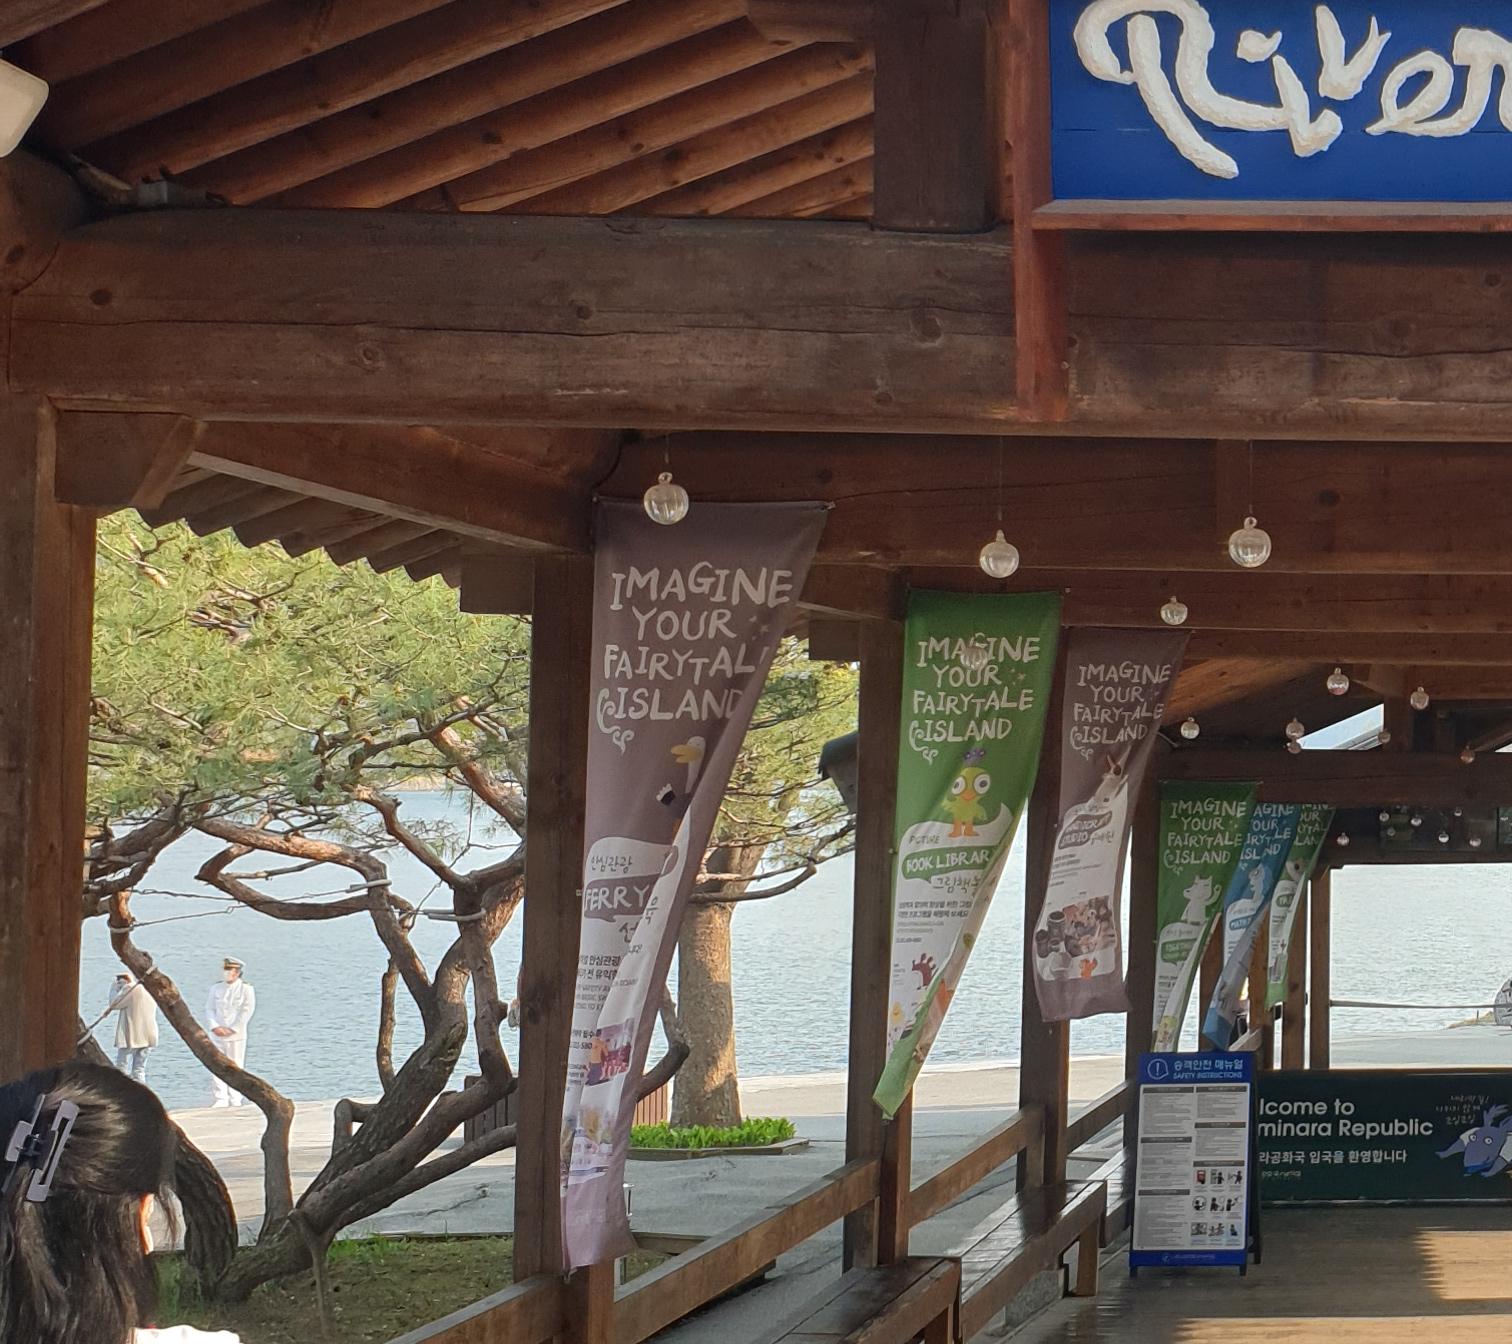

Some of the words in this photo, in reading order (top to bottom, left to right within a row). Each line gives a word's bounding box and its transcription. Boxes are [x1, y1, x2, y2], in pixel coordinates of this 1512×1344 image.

[610, 561, 793, 611] IMAGINE
[632, 606, 737, 641] YOUR
[604, 643, 770, 685] FAIRYTAL
[1077, 661, 1171, 686] IMAGINE
[932, 664, 1002, 688] YOUR
[913, 686, 1035, 717] FAIRYTALE
[1090, 685, 1145, 702] YOUR
[1073, 702, 1165, 726] FAIRYTALE
[922, 718, 1012, 742] ISLAND
[1081, 724, 1148, 744] ISLAND
[1169, 798, 1248, 819] IMAGINE
[1181, 816, 1225, 831] YOUR
[1167, 831, 1242, 849] FAIRYTALE
[906, 857, 933, 873] BOOK
[1173, 850, 1231, 864] ISLAND
[584, 885, 650, 912] FERRY
[1334, 1098, 1355, 1115] to
[1258, 1119, 1332, 1137] minara
[1339, 1118, 1433, 1140] Republic
[1309, 1150, 1345, 1164] 입국을
[1348, 1149, 1408, 1163] 환영합니다
